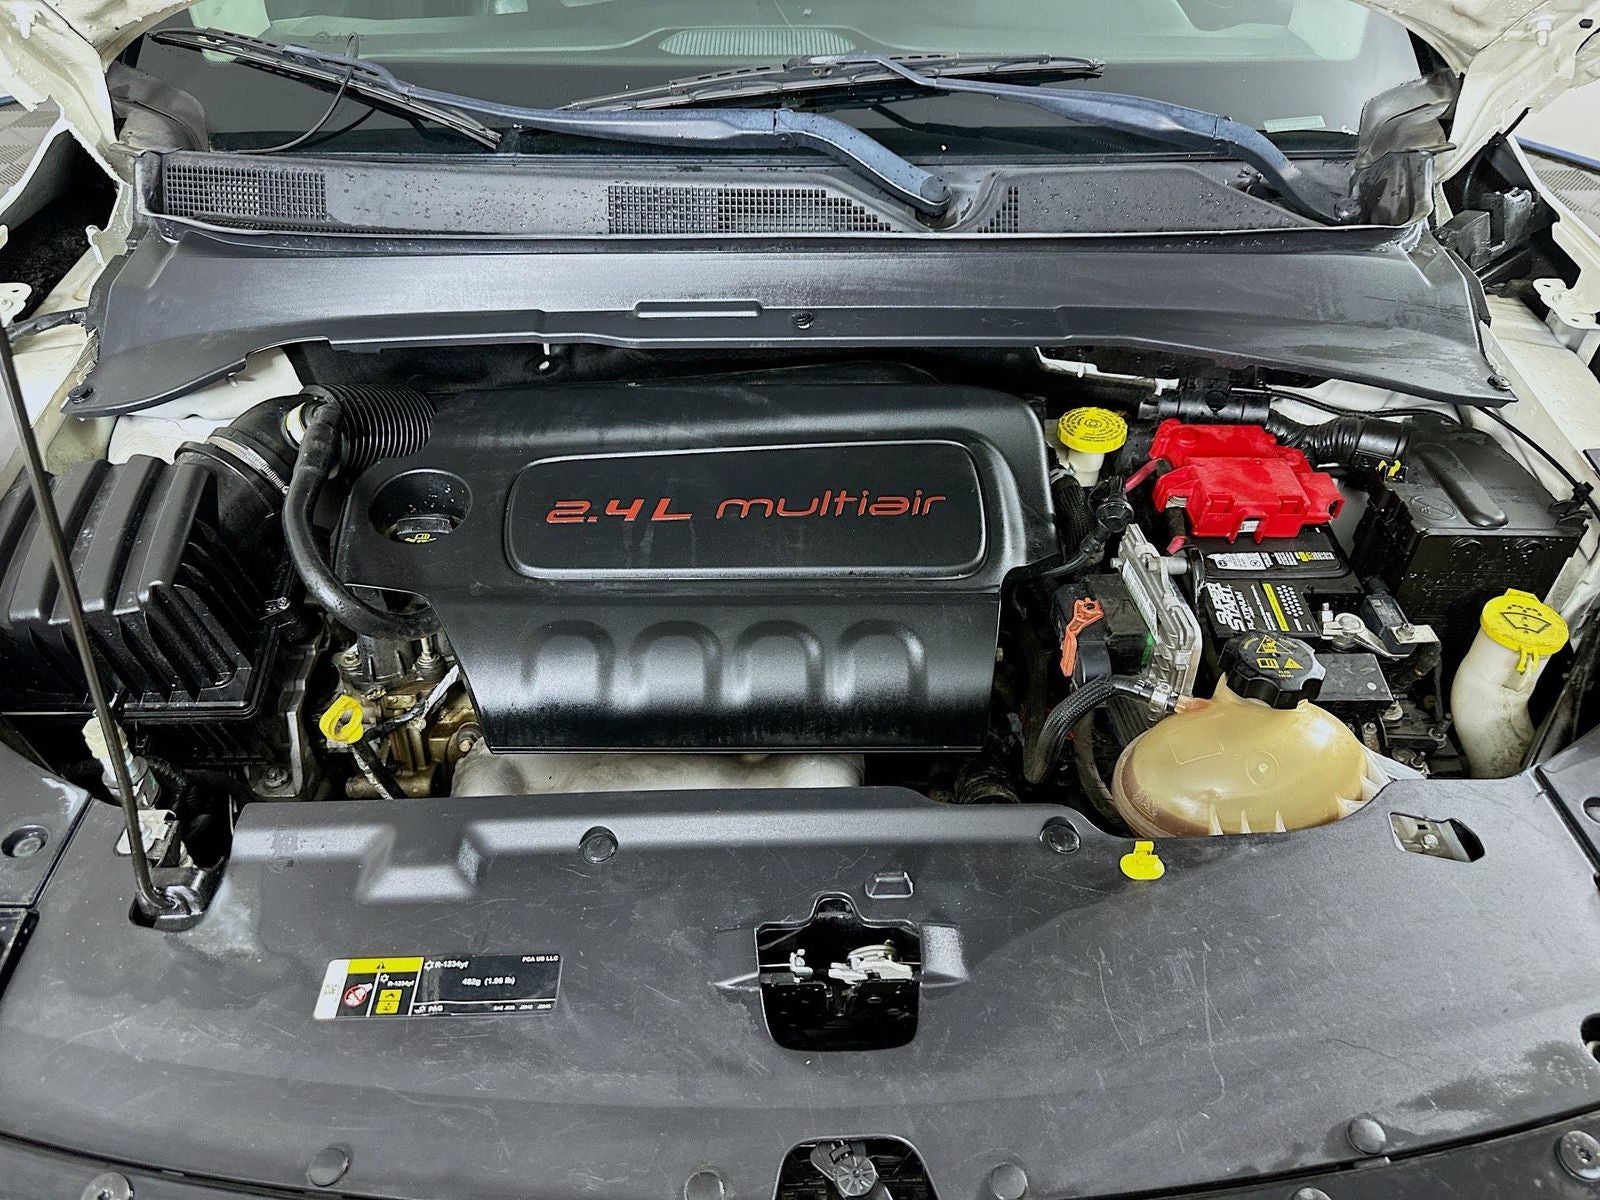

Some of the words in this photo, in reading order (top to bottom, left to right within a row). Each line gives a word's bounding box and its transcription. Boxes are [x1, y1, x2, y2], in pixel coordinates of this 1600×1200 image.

[546, 498, 693, 524] 2.4L
[716, 489, 946, 520] multiair
[1205, 583, 1229, 625] SUPER
[1219, 583, 1247, 632] START
[1234, 591, 1256, 630] PLATINUM
[434, 960, 469, 970] R-1234yf
